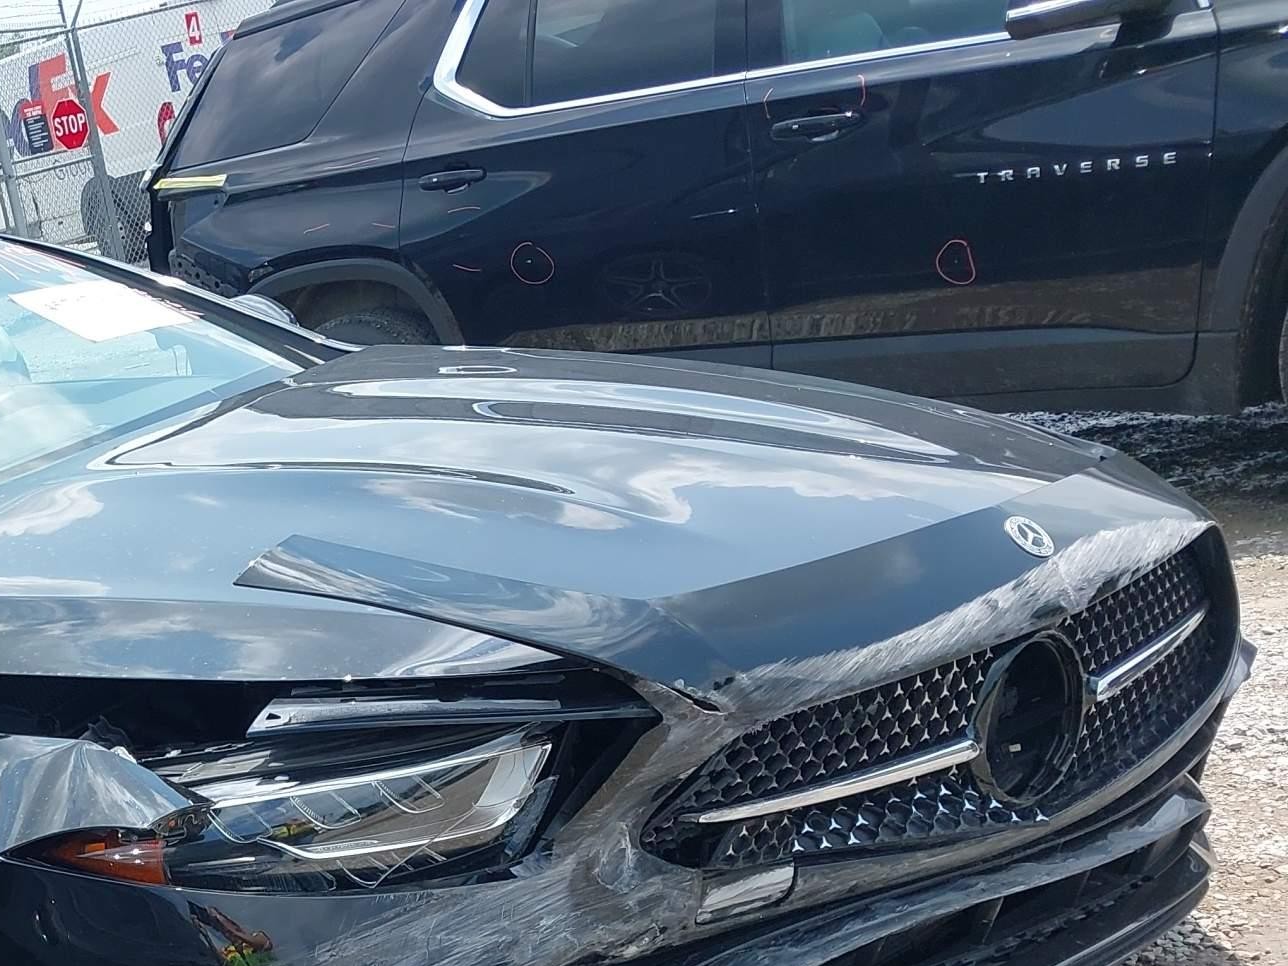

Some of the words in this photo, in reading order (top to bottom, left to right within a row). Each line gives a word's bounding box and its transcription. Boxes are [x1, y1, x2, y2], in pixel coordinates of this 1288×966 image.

[187, 16, 200, 43] 4
[54, 113, 86, 137] STOP
[976, 151, 1177, 184] TRAVERSE
